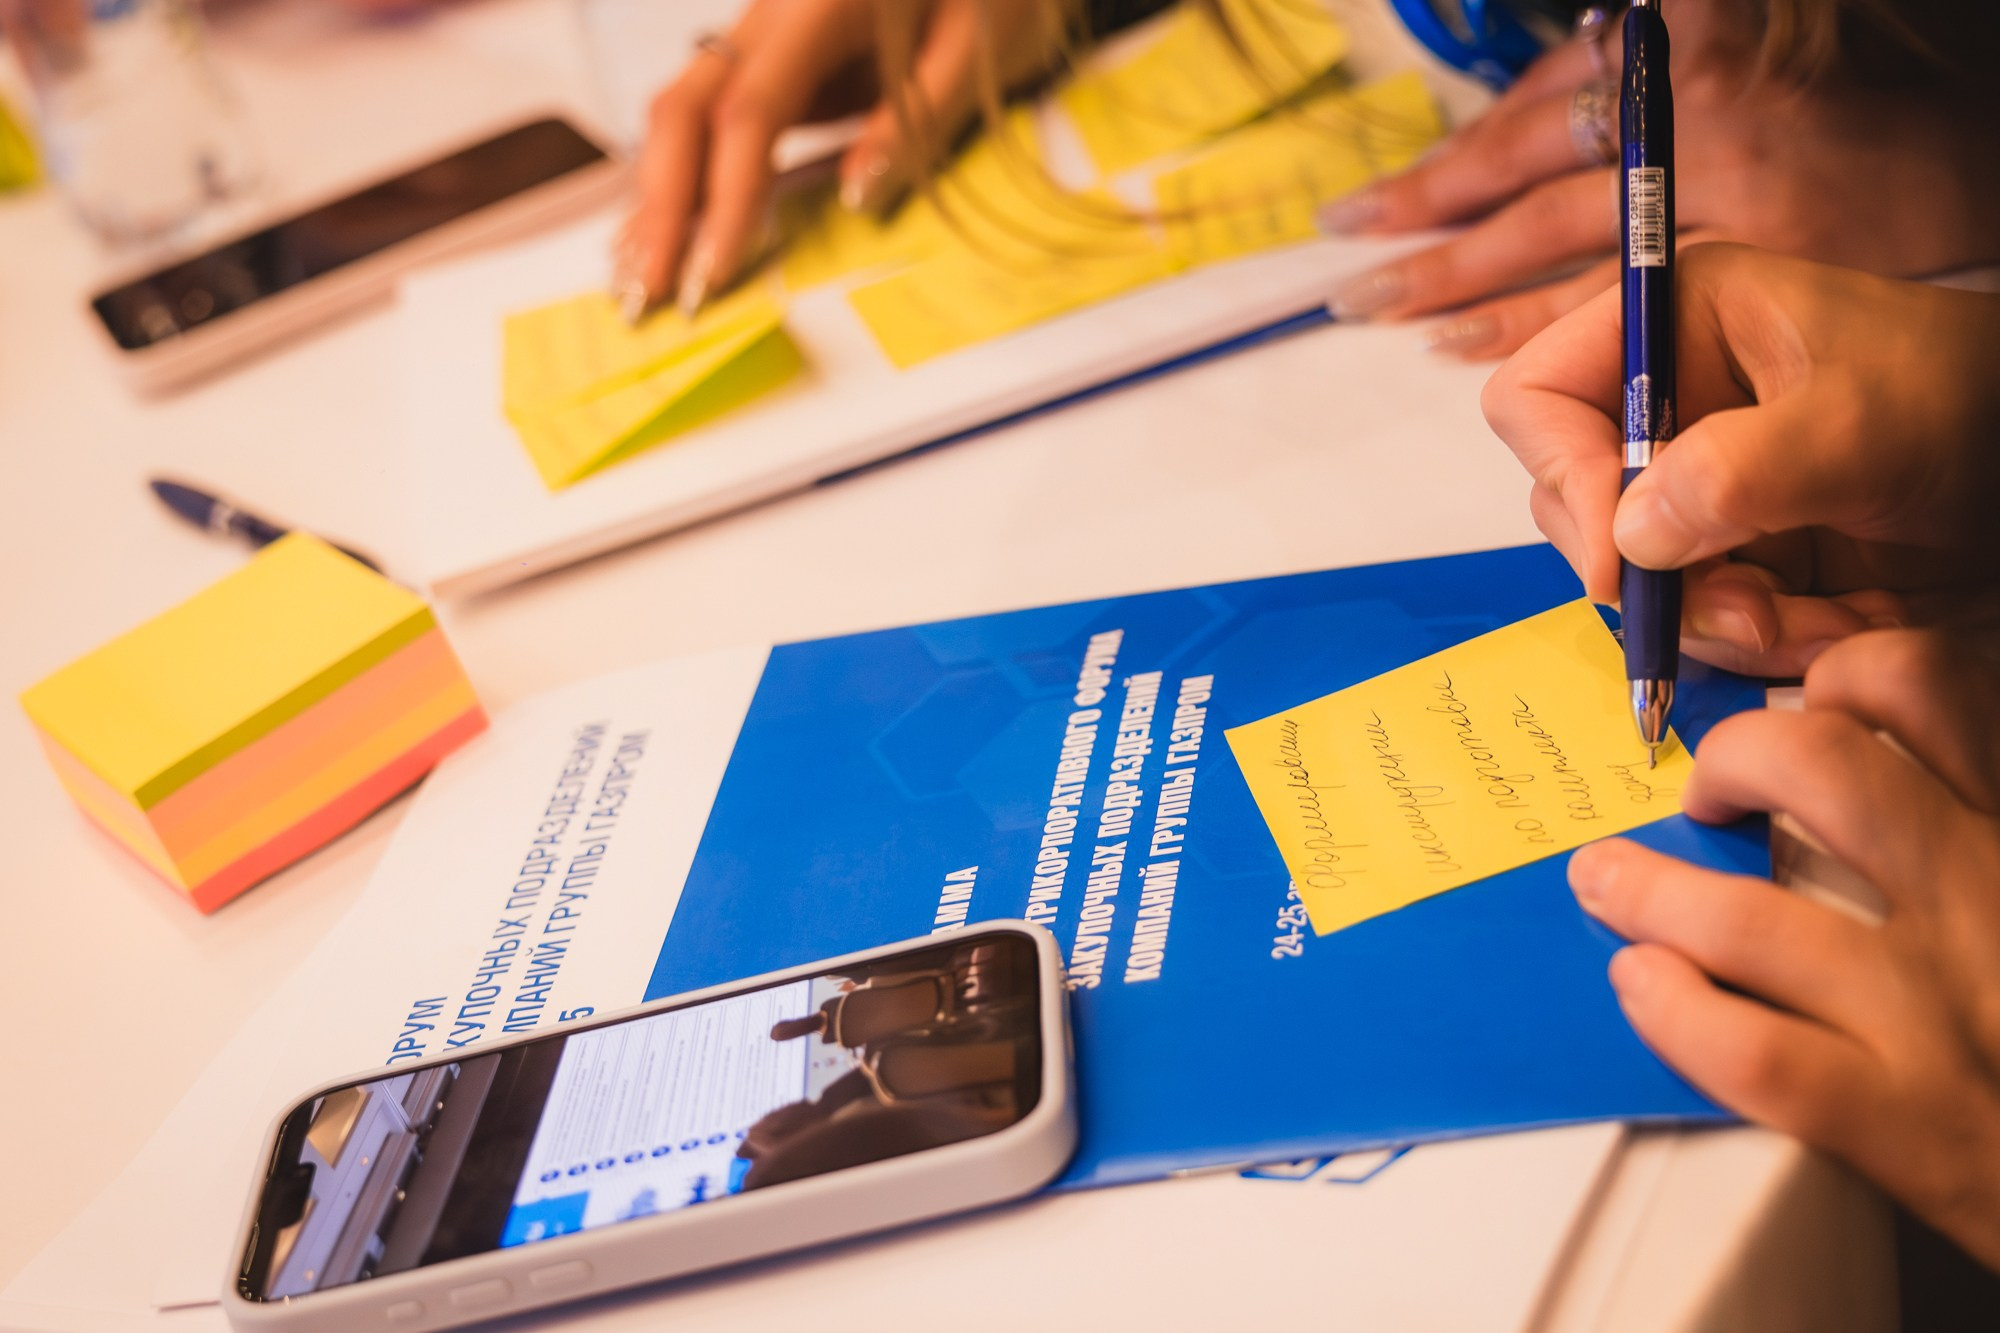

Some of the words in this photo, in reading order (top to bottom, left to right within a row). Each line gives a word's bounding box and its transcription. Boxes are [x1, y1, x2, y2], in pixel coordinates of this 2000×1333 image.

[1630, 225, 1639, 263] 142692
[1025, 708, 1102, 933] ТРИКОРПОРАТИВНОГО
[1073, 628, 1124, 706] ФОРУМА
[1097, 671, 1163, 838] ПОДРАЗДЕЛЕНИЙ
[1166, 674, 1214, 764] ГАЗПРОМ
[506, 720, 608, 909] ПОДРАЗДЕЛЕНИЙ
[543, 836, 611, 934] ГРУППЫ
[585, 729, 650, 831] ГАЗПРОМ
[1149, 767, 1196, 857] ГРУППЫ
[1071, 840, 1127, 989] ЗАКУПОЧНЫХ
[1124, 859, 1180, 984] КОМПАНИЙ
[1271, 905, 1308, 960] 24-25
